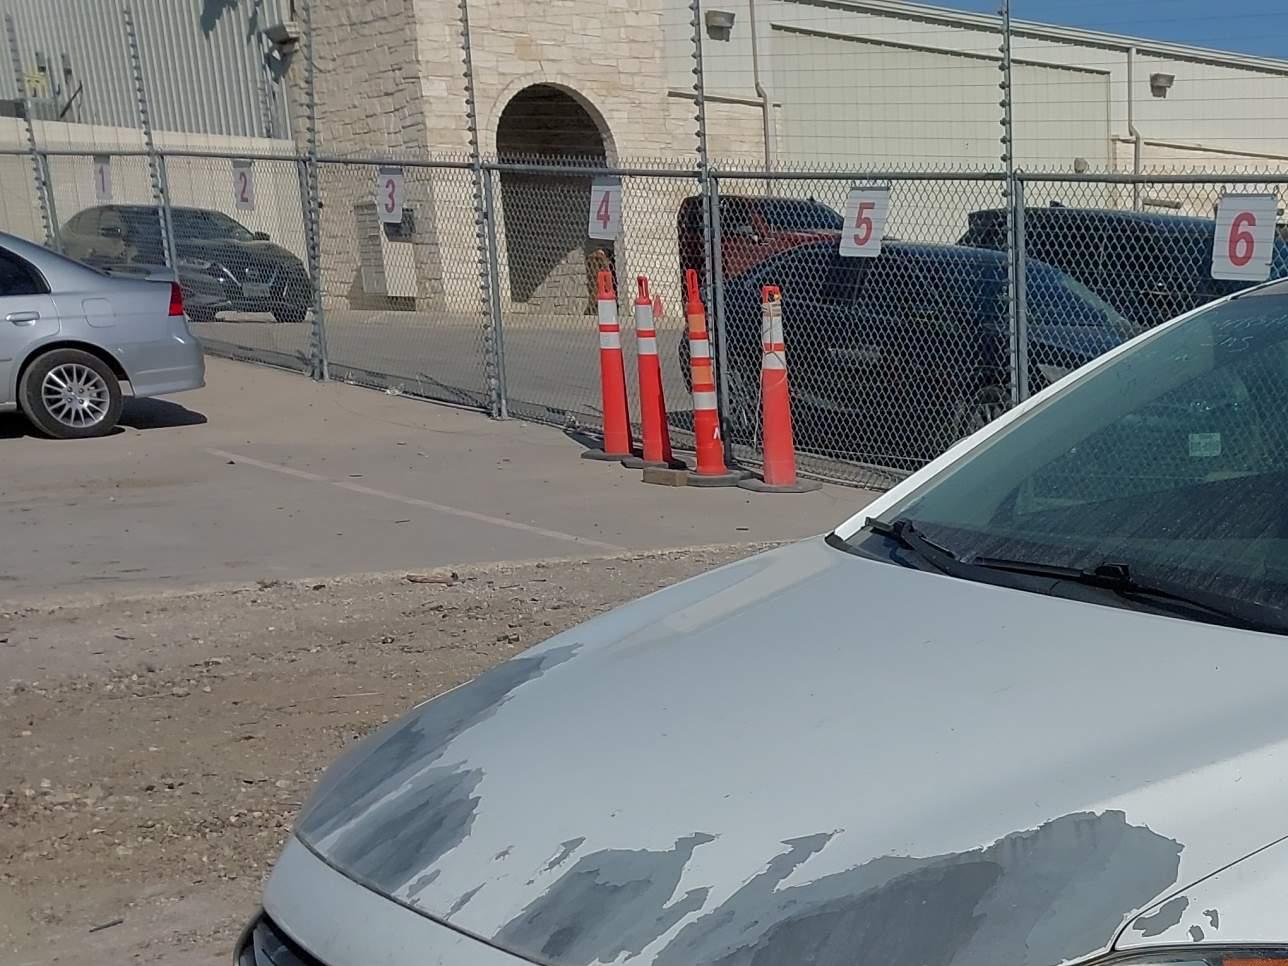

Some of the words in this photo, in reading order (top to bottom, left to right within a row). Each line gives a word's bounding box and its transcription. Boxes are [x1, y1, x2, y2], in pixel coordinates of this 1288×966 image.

[239, 171, 249, 203] 2
[384, 178, 396, 214] 3
[596, 190, 611, 230] 4
[853, 202, 876, 247] 5
[1227, 211, 1258, 268] 6
